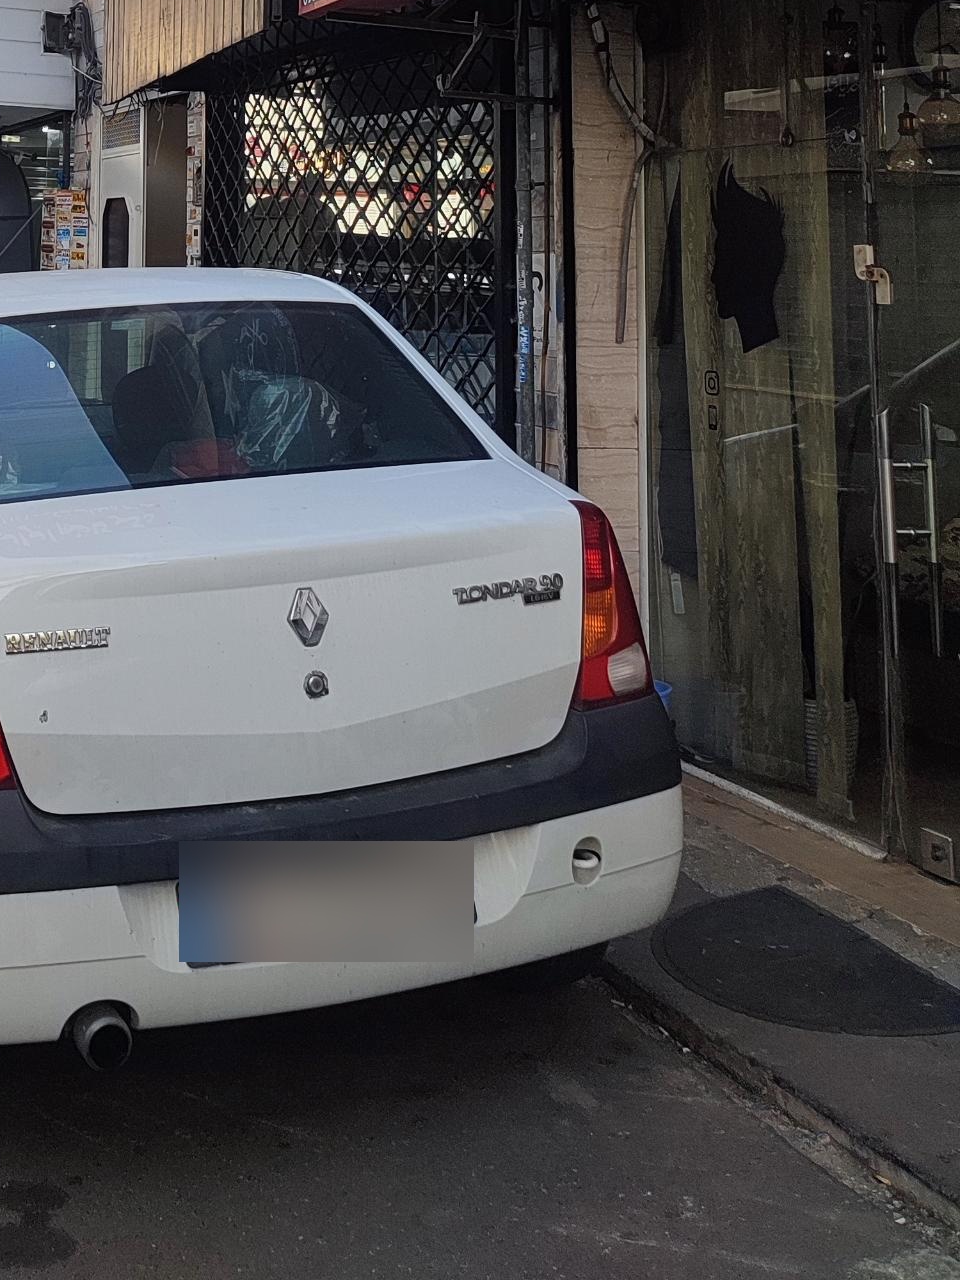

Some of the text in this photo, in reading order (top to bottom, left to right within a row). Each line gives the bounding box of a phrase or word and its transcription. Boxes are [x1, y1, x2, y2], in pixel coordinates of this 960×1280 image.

[452, 572, 564, 605] TONDAR 90
[4, 626, 111, 655] RENAULT
